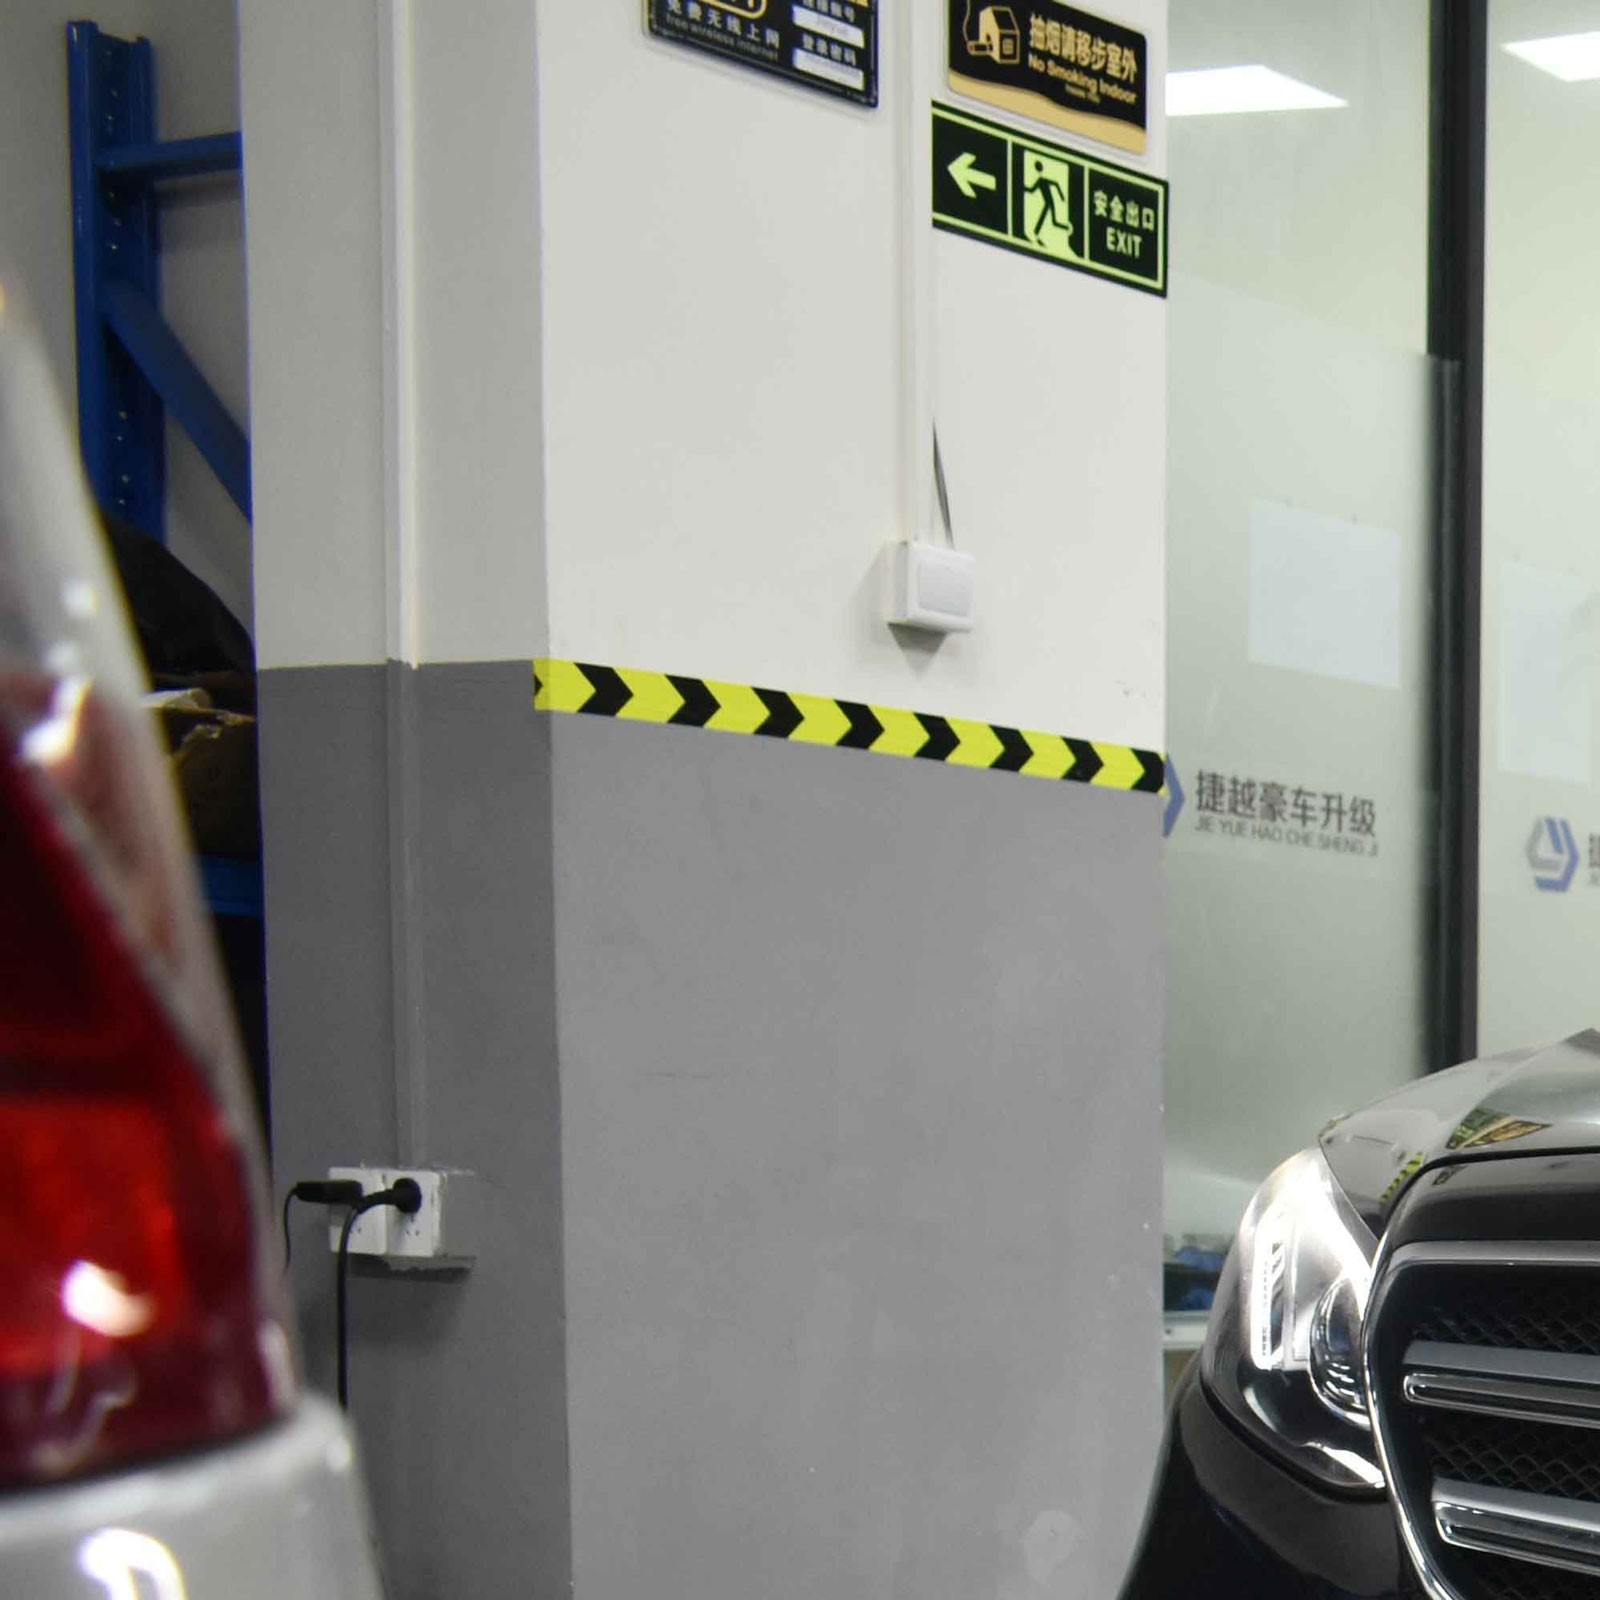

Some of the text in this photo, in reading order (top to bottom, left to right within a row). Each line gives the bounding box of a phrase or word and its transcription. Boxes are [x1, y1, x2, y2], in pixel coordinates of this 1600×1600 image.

[1028, 53, 1046, 72] No
[1046, 60, 1098, 94] Smoking
[1093, 190, 1155, 232] 安全出口
[1106, 226, 1142, 258] EXIT
[1196, 770, 1376, 837] 捷越豪车升级
[1219, 819, 1249, 838] YUE
[1252, 823, 1283, 842] HAO
